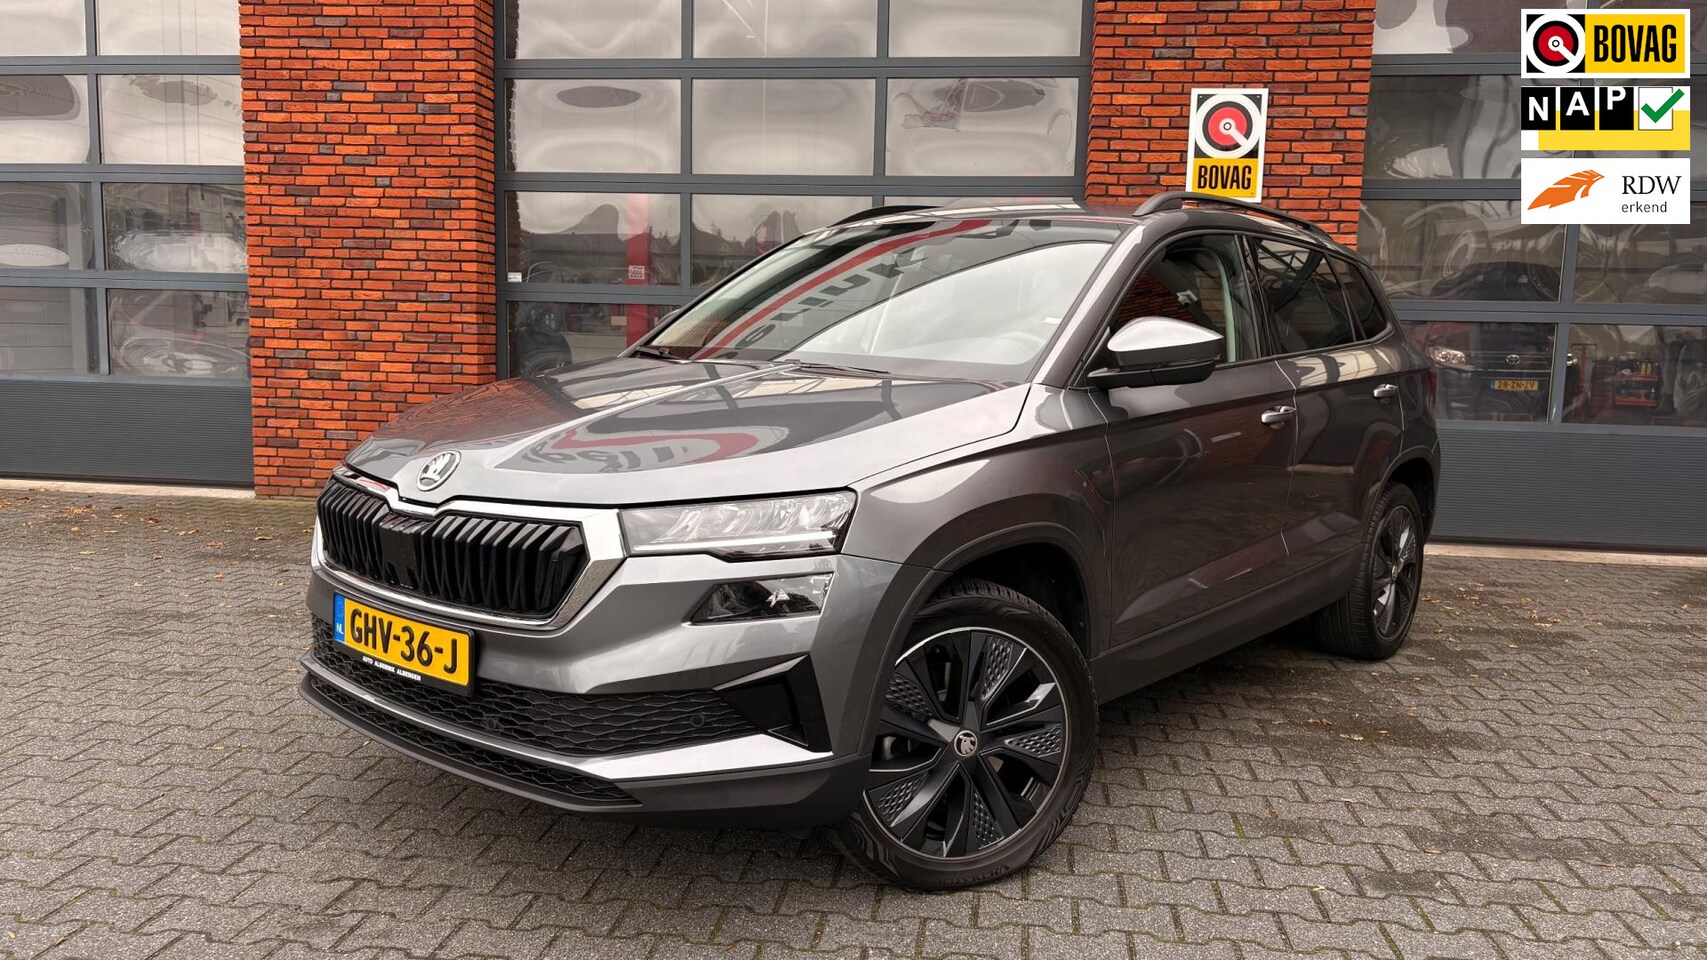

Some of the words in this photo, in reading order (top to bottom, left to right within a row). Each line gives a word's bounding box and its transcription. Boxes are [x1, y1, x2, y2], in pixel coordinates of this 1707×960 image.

[1197, 165, 1252, 190] BOVAG
[336, 622, 344, 635] NL
[350, 608, 458, 674] GHV-36-J
